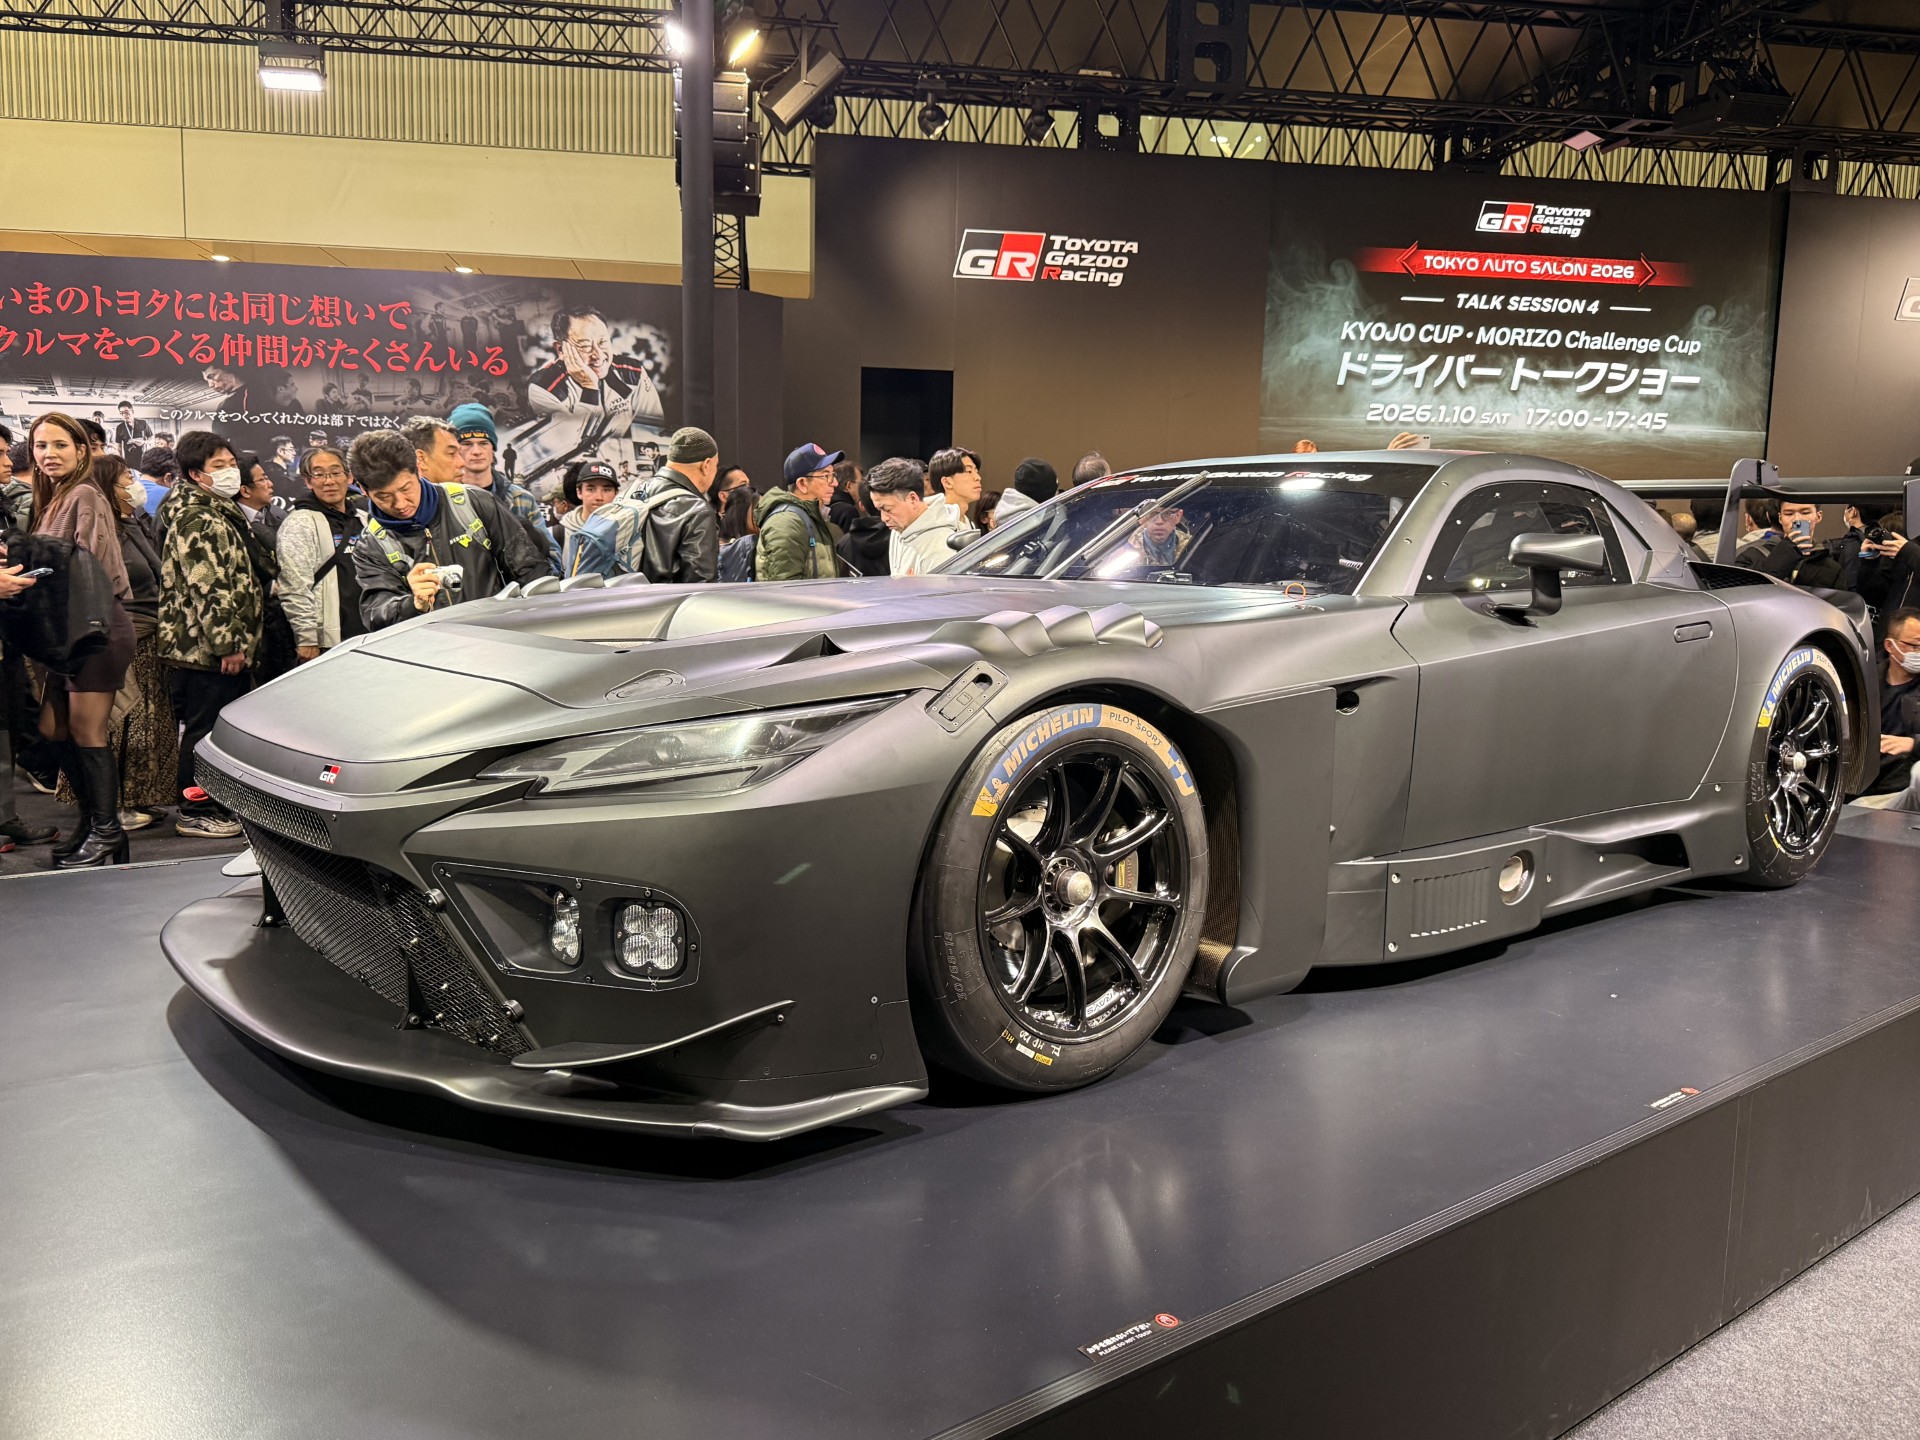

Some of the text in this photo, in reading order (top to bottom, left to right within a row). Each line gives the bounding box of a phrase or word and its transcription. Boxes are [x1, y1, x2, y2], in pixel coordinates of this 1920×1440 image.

[1479, 213, 1528, 231] GR
[1532, 215, 1585, 226] GAZOO
[1535, 205, 1591, 218] TOYOTA
[1530, 224, 1581, 237] Racing
[1050, 235, 1139, 253] TOYOTA
[959, 249, 1037, 278] GR
[1044, 251, 1129, 269] GAZOO
[1424, 255, 1635, 279] TOKYO AUTO SALON 2026
[1041, 266, 1124, 287] Racing
[0, 281, 412, 330] いまのトヨタには同じ想いで
[1456, 293, 1600, 315] TALK SESSION 4
[1340, 321, 1416, 343] KYOJO
[1564, 330, 1661, 353] Challenge
[1664, 335, 1701, 356] Cup
[0, 324, 509, 376] クルマをつくる仲間がたくさんいる
[1366, 403, 1476, 423] 2026.1.10
[1479, 412, 1511, 424] SAT
[1771, 651, 1811, 699] MICHELIN
[1109, 711, 1163, 747] PILOT SPORT
[1002, 707, 1094, 778] MICHELIN
[319, 771, 337, 785] GR
[1086, 992, 1115, 1015] RAYS
